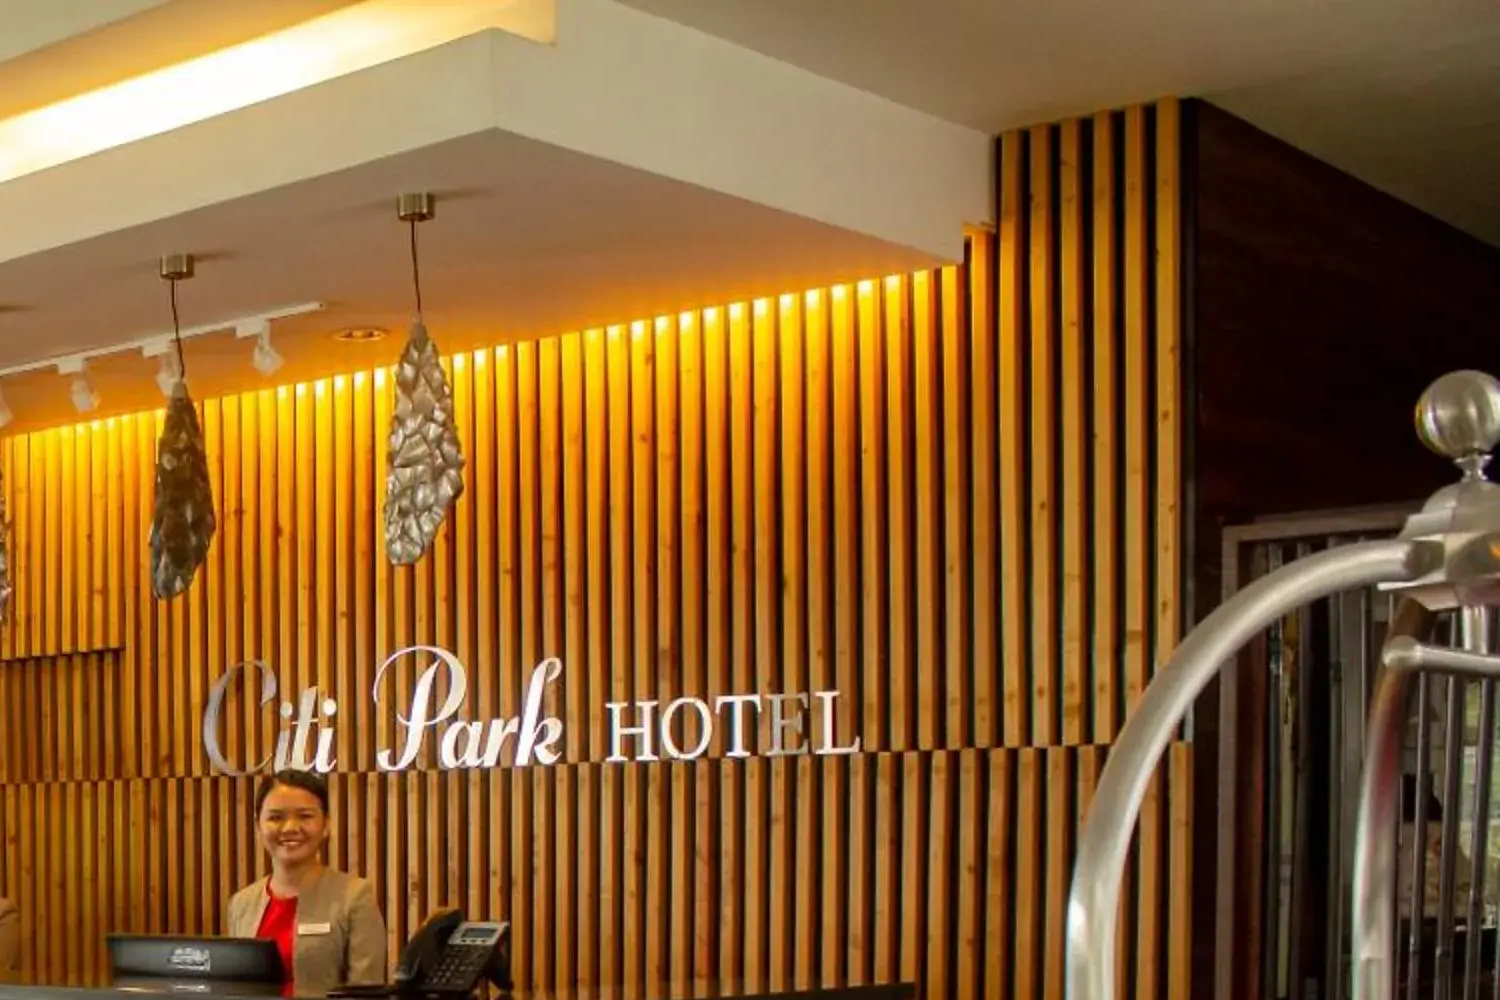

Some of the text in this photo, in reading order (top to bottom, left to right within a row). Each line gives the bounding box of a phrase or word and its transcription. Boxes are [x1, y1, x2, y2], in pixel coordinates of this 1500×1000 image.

[203, 645, 861, 776] Citi Park HOTEL
